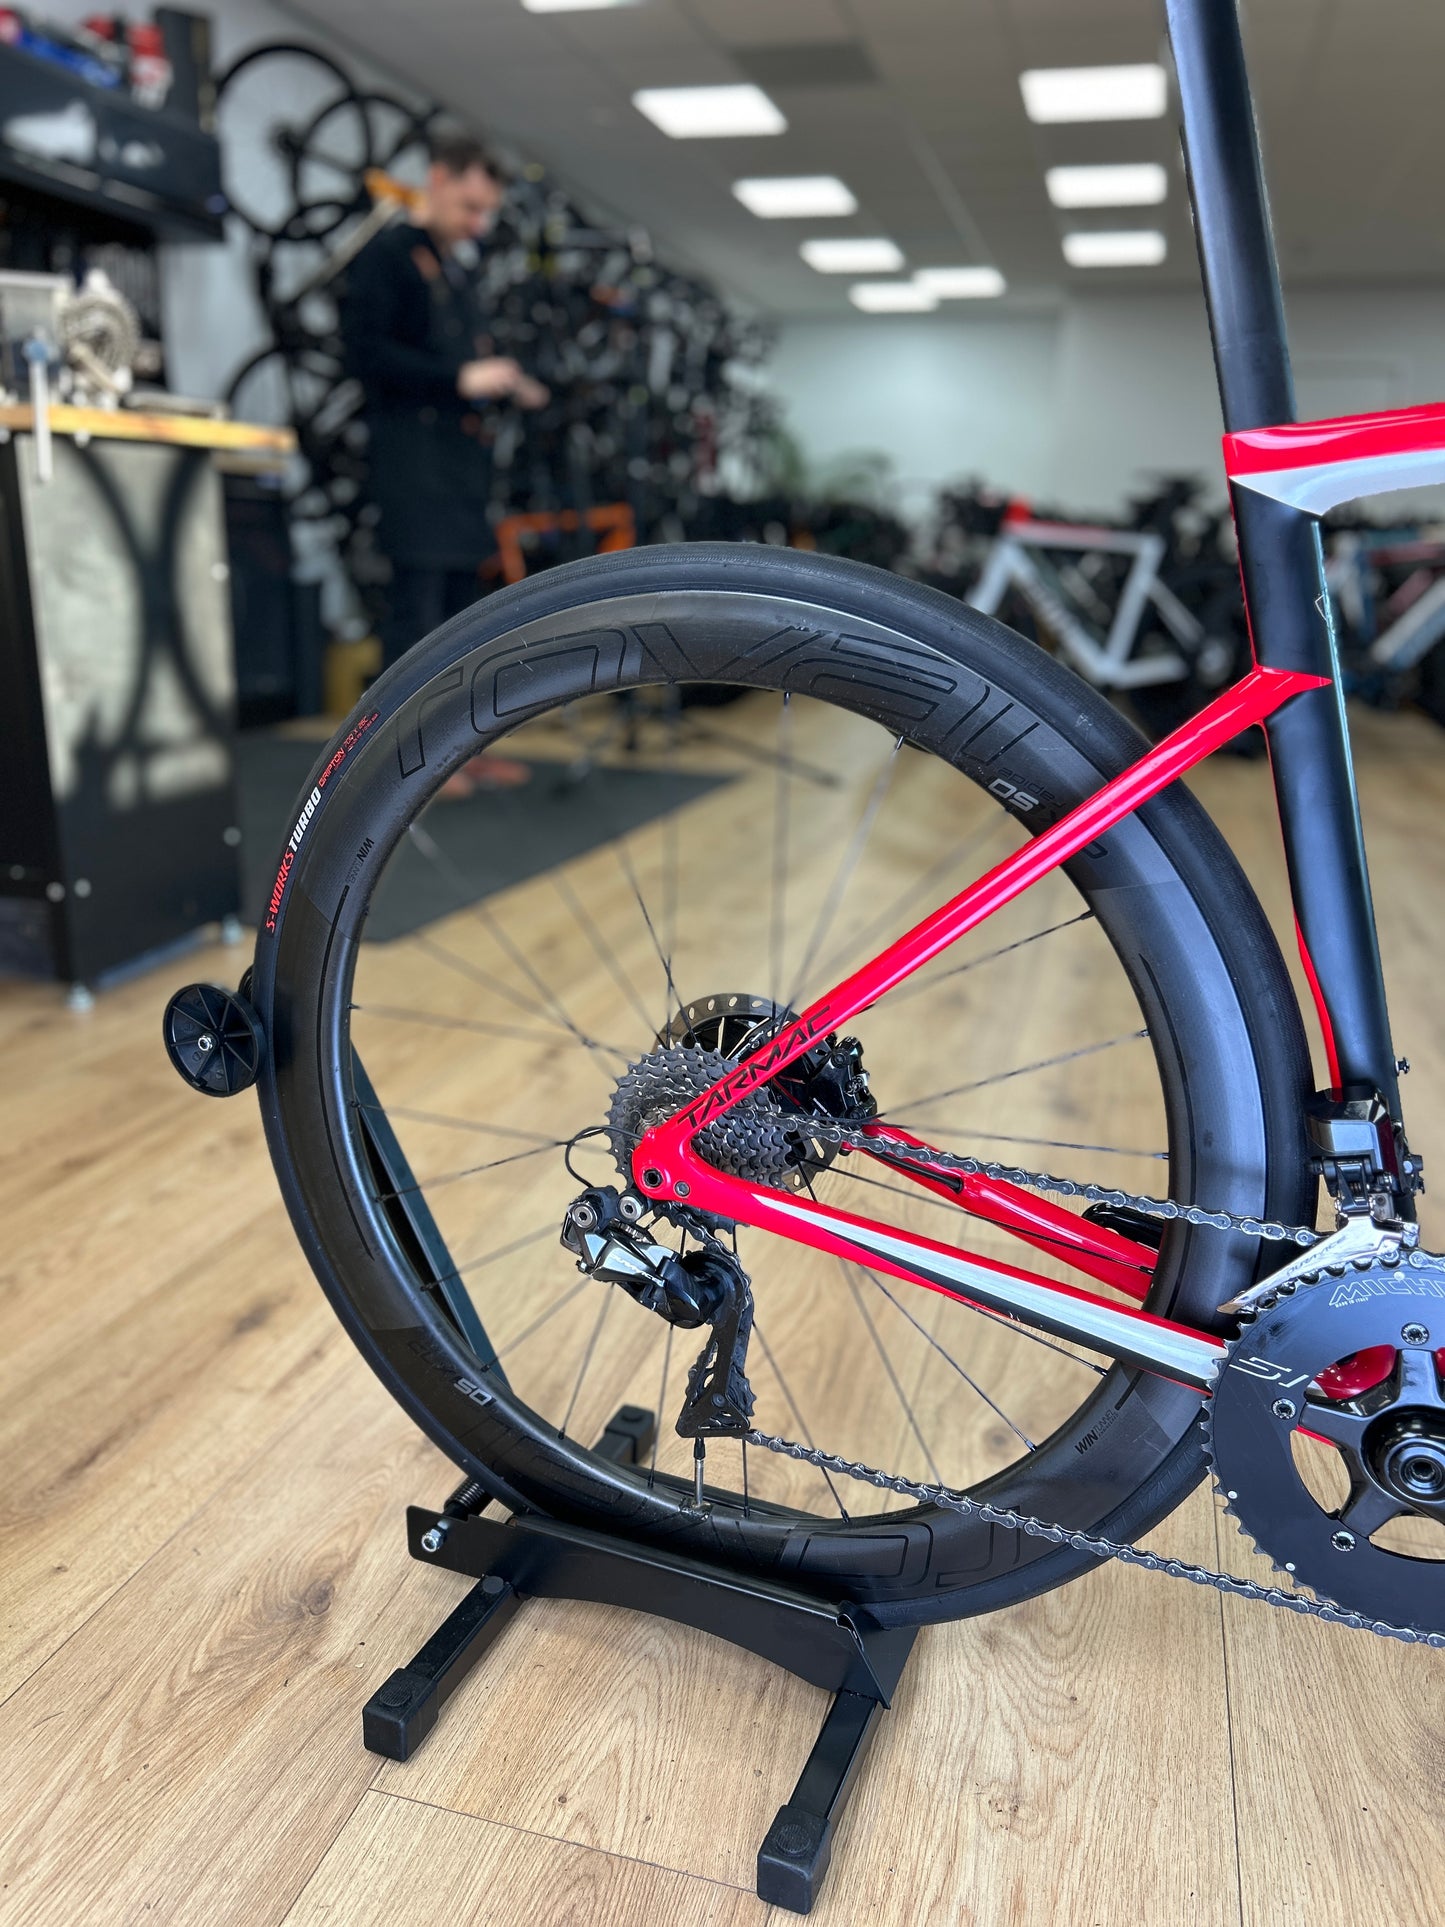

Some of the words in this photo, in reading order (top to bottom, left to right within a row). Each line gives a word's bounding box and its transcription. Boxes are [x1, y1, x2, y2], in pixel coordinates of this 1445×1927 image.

[265, 847, 295, 933] S-WORKS
[287, 786, 322, 852] TURBO
[318, 749, 346, 788] GRIPTON
[357, 838, 374, 863] WIN
[678, 1006, 834, 1128] TARMAC
[1329, 1278, 1445, 1307] MICH
[453, 1377, 493, 1406] 50
[1074, 1429, 1099, 1455] WIN
